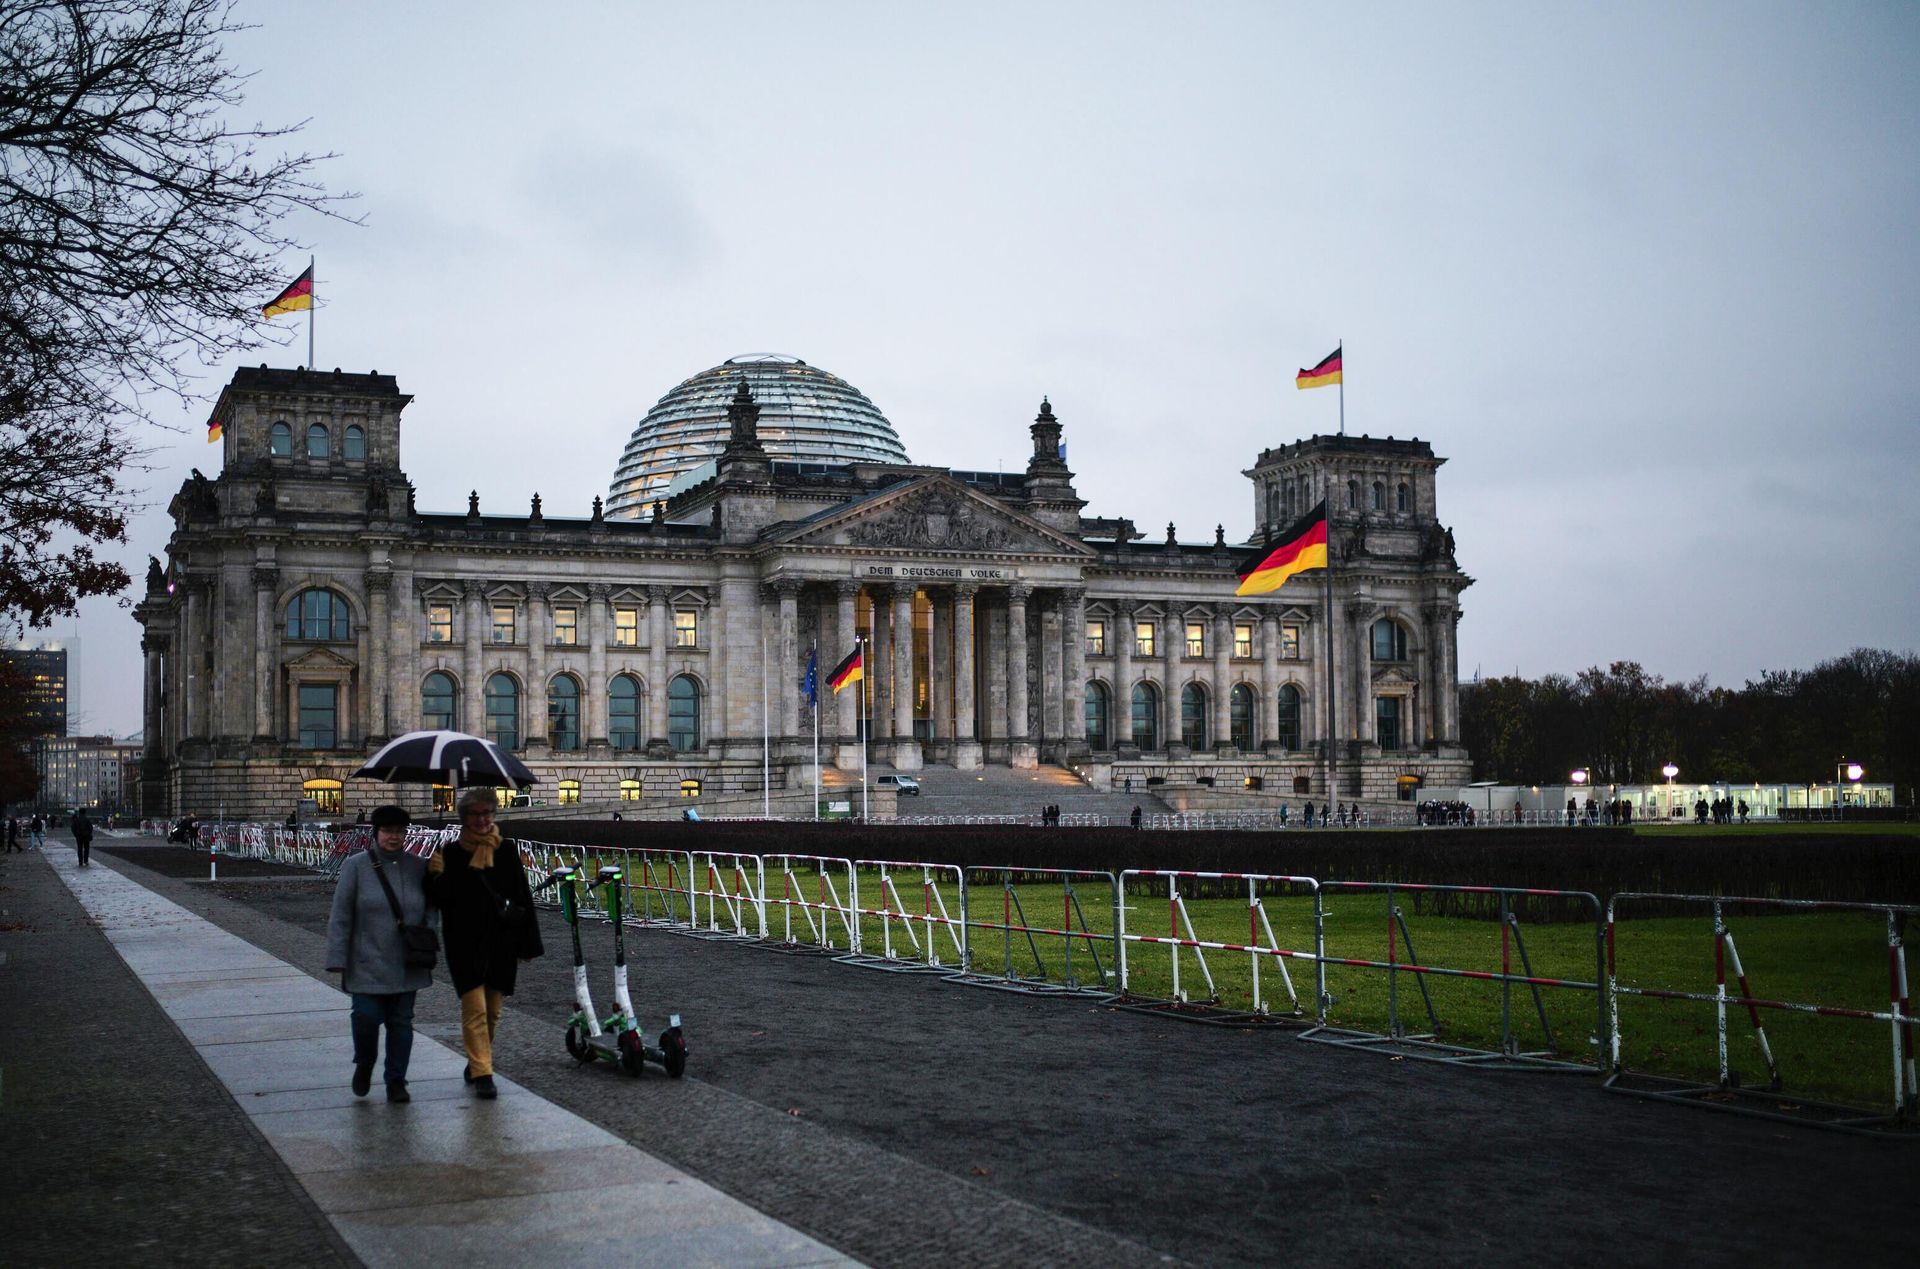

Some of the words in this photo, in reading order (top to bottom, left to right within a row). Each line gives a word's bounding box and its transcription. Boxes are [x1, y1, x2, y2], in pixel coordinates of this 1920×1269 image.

[869, 566, 893, 575] DEM
[901, 567, 962, 577] DEUTSCHEN
[970, 569, 1001, 578] VOLKE
